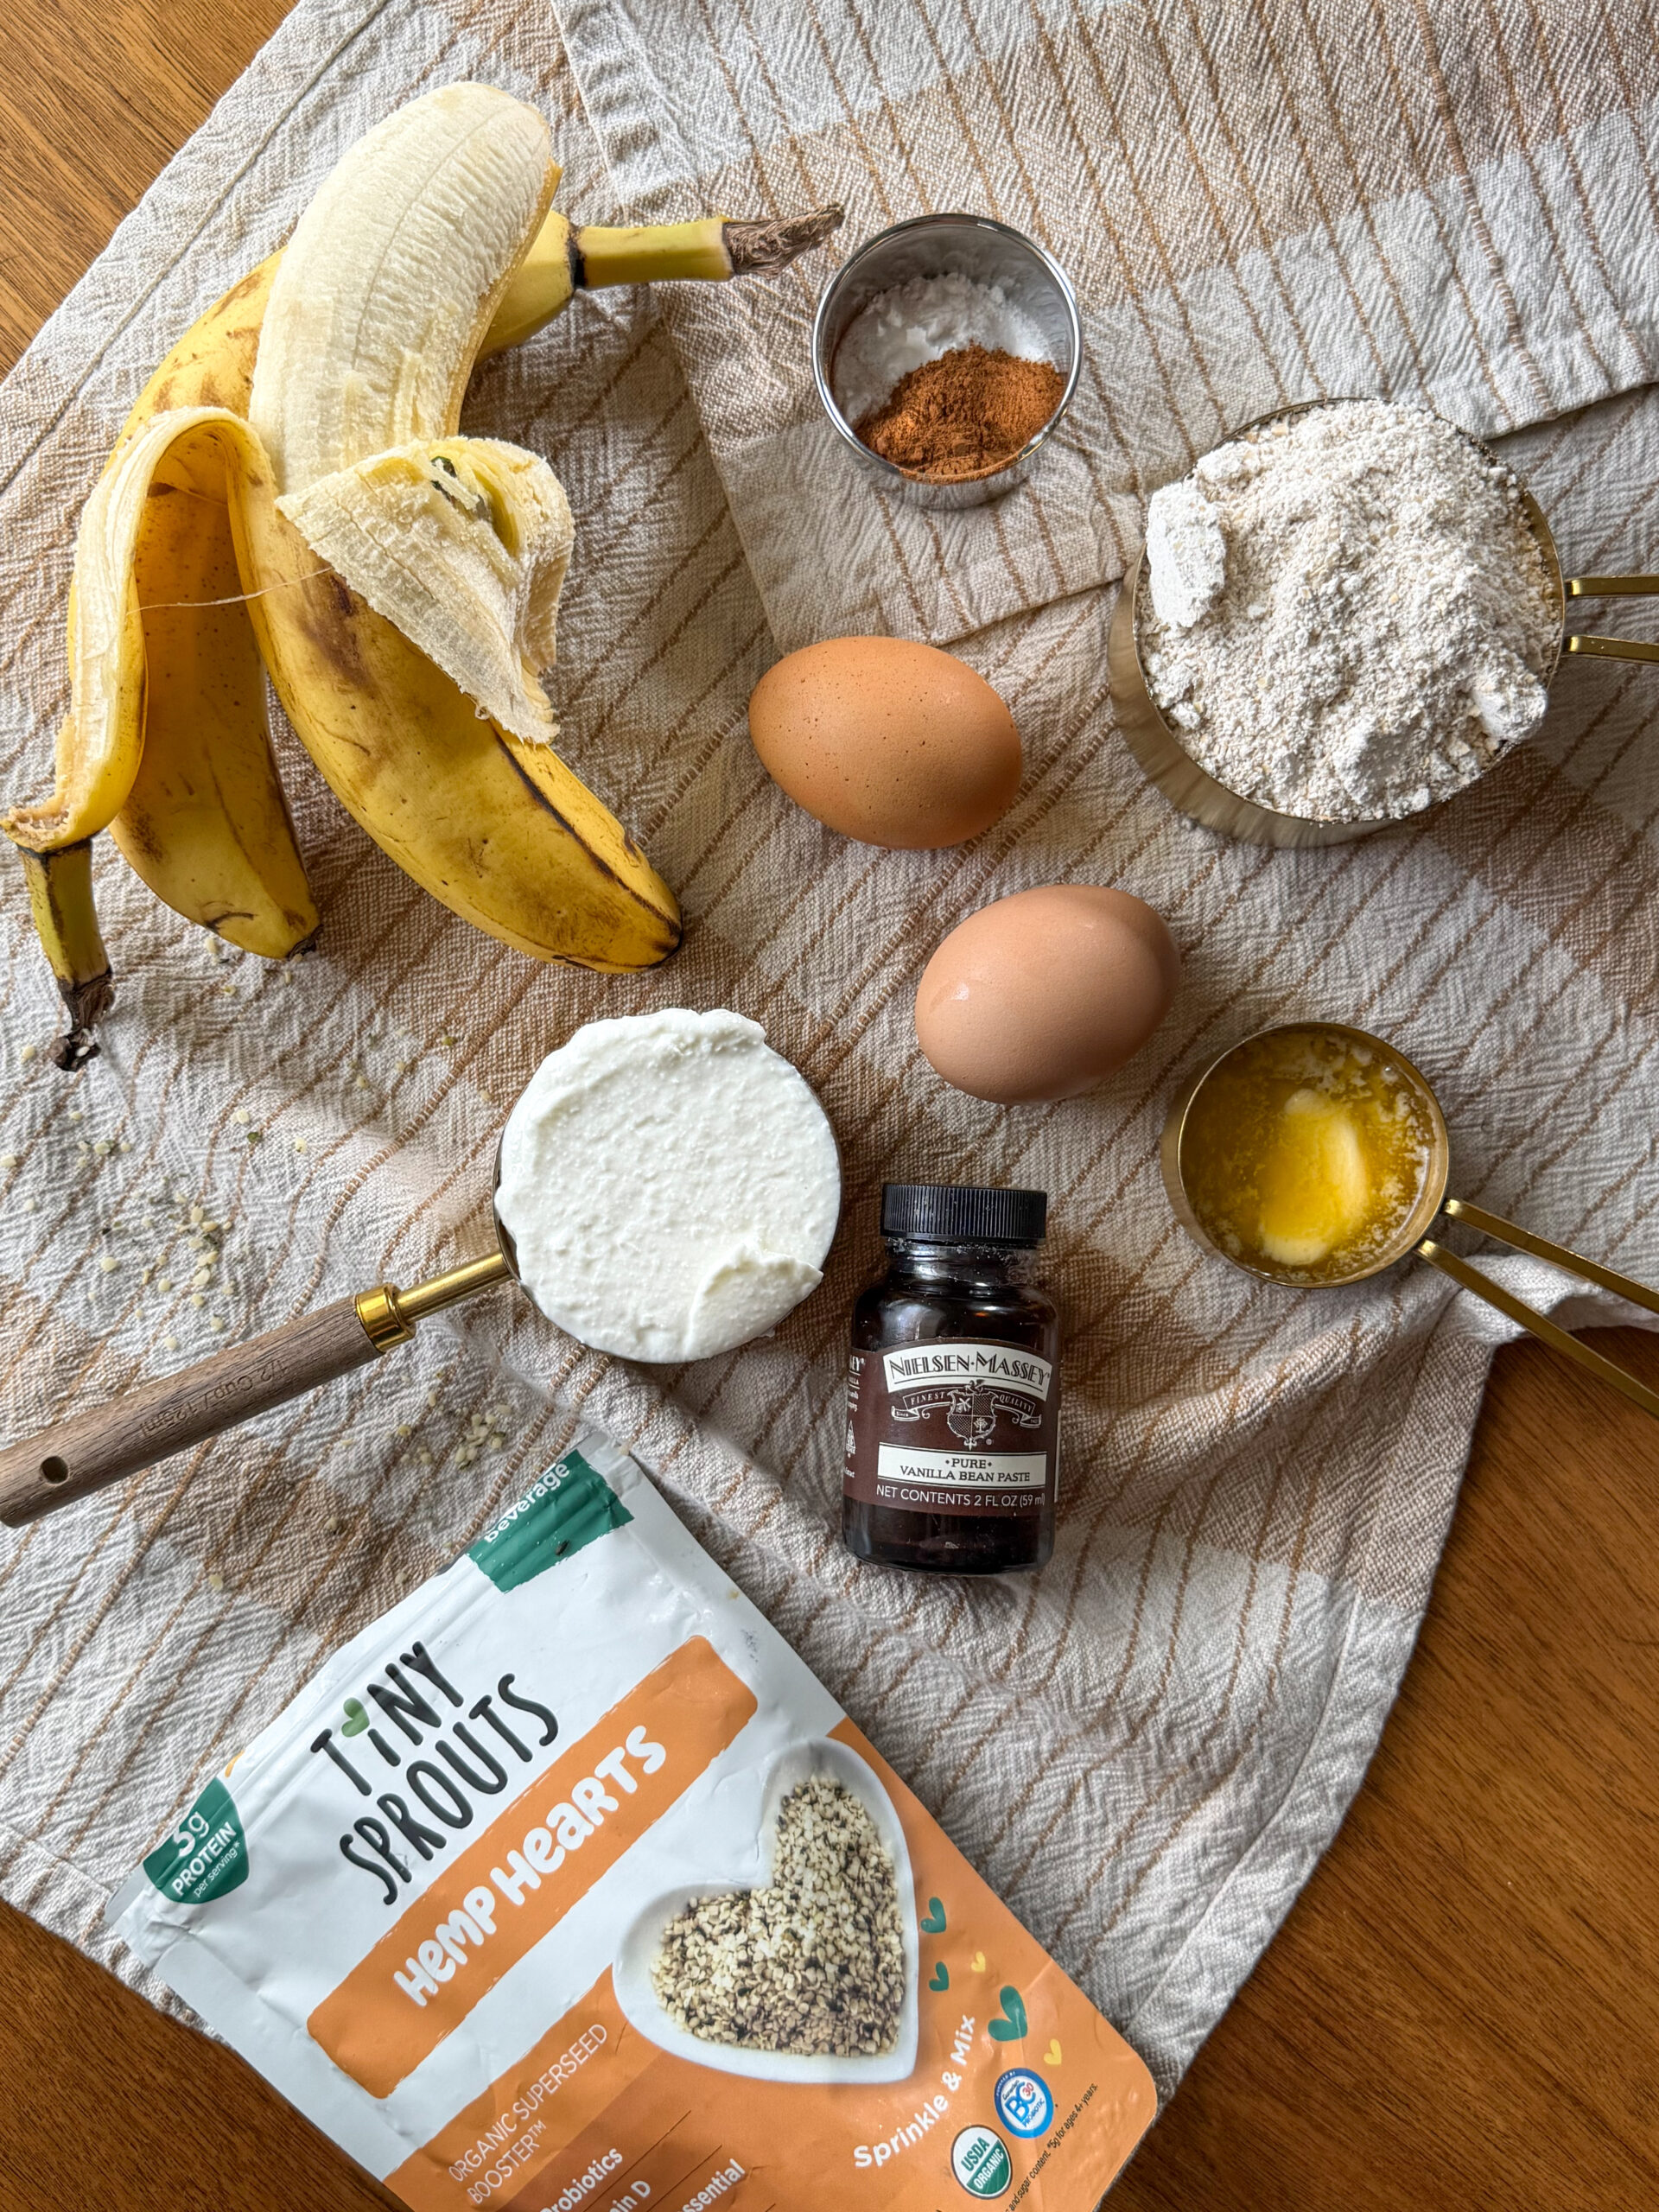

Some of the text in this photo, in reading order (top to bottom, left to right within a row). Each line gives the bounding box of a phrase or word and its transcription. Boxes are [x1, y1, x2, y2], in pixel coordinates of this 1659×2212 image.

[213, 1374, 253, 1399] Cup
[911, 1392, 1034, 1414] FINEST QUALITY
[900, 1465, 1031, 1483] VANILLA BEAN PASTE
[484, 1463, 570, 1543] beverage
[876, 1484, 898, 1498] NET
[900, 1488, 971, 1507] CONTENTS
[974, 1494, 982, 1507] 2
[1019, 1494, 1033, 1509] (59
[339, 1673, 560, 1906] SPROUTS
[171, 1821, 237, 1897] PROTEIN
[193, 1878, 208, 1898] per
[448, 2024, 607, 2182] ORGANIC SUPERSEED
[853, 2014, 976, 2169] Sprinkle & Mix
[1022, 2097, 1046, 2127] PROBIOTIC
[961, 2136, 991, 2172] USDA
[973, 2146, 1005, 2190] ORGANIC
[1008, 2194, 1020, 2211] and
[1016, 2176, 1032, 2198] sugar
[1056, 2126, 1067, 2140] for
[1064, 2110, 1078, 2130] ages
[631, 2180, 652, 2198] D
[678, 2158, 746, 2212] ssential
